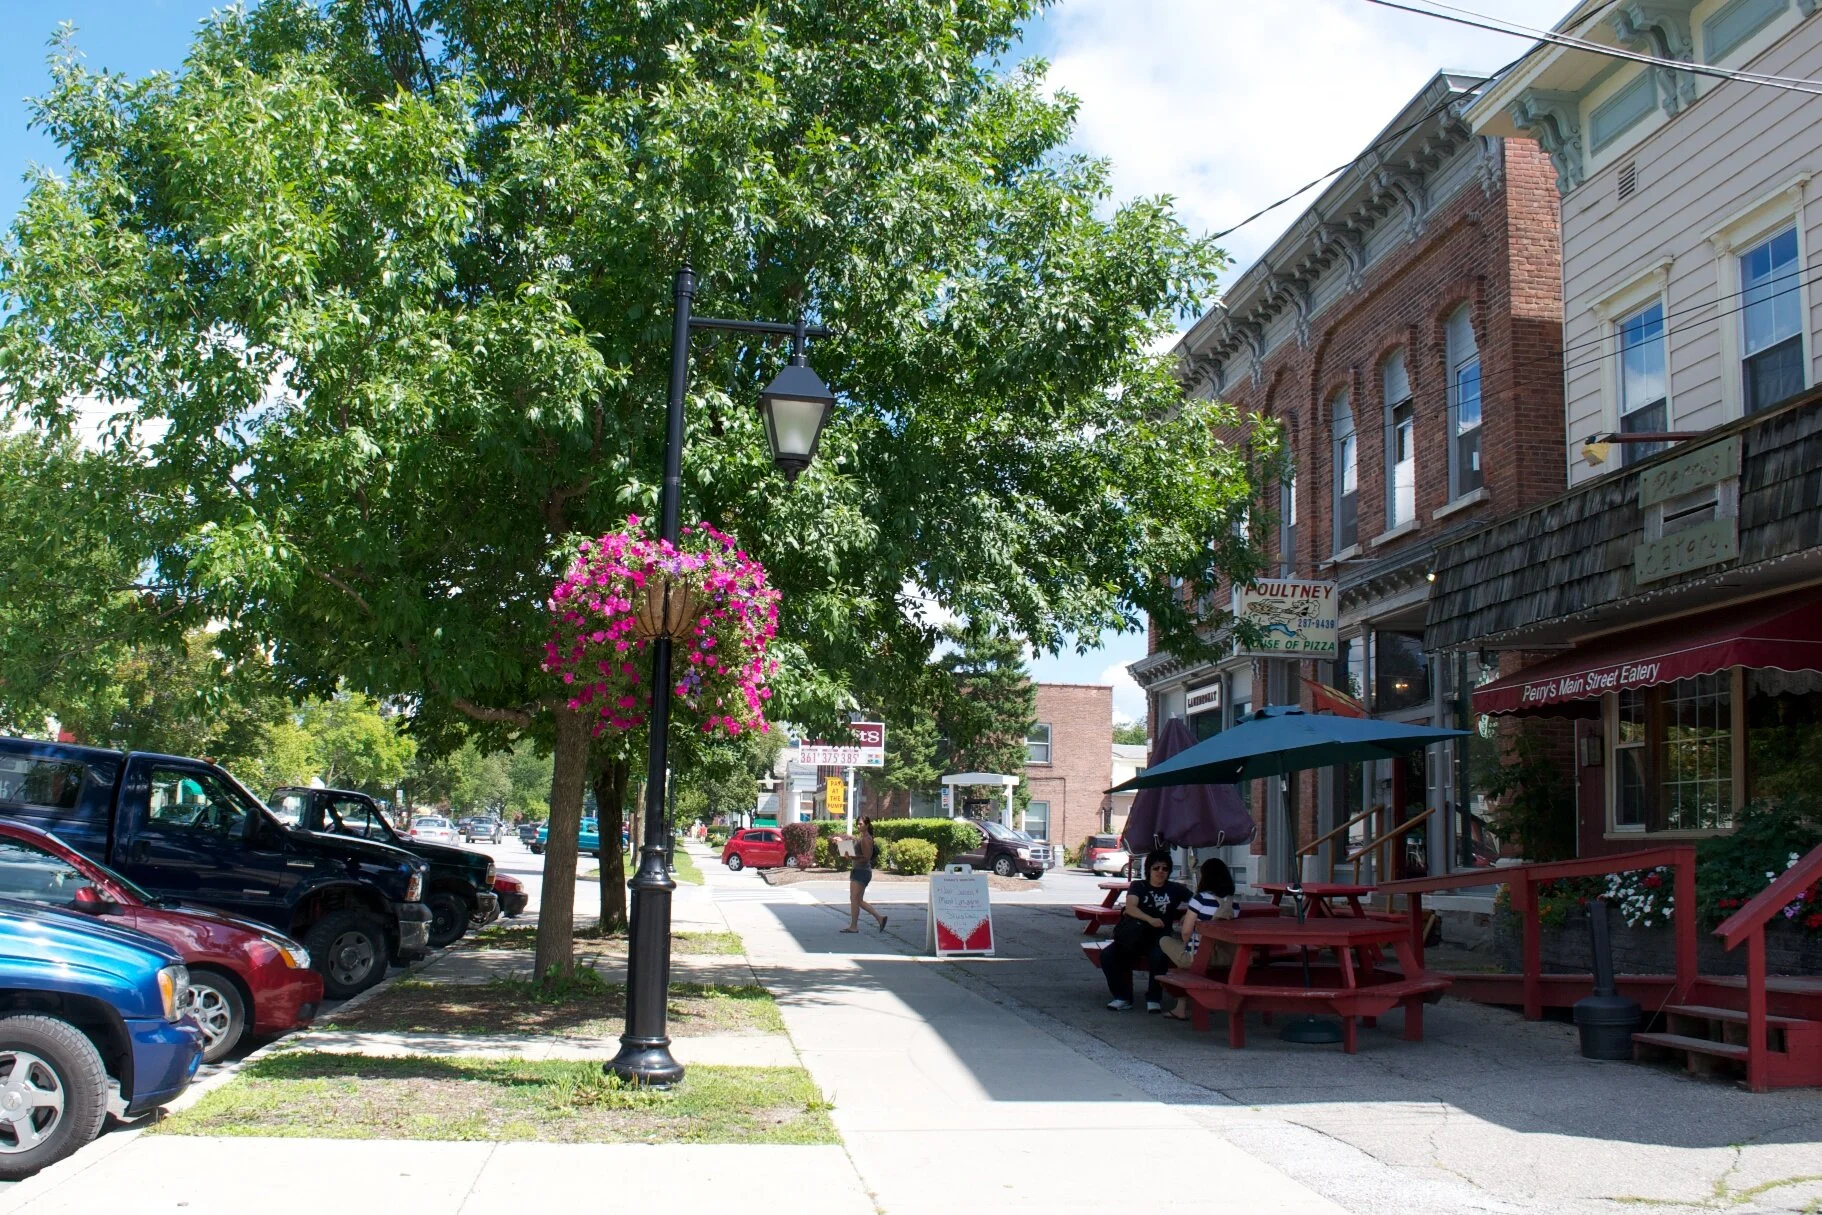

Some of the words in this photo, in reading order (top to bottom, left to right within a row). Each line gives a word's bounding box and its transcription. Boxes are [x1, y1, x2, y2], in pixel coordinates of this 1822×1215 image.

[1245, 583, 1333, 600] POULTNEY
[1298, 618, 1335, 629] 287-9439
[1285, 640, 1299, 649] OF
[1303, 640, 1335, 652] PIZZA
[1522, 681, 1557, 703] Perry's
[1558, 676, 1584, 696] Main
[1585, 668, 1619, 691] Street
[1619, 662, 1660, 684] Eatery
